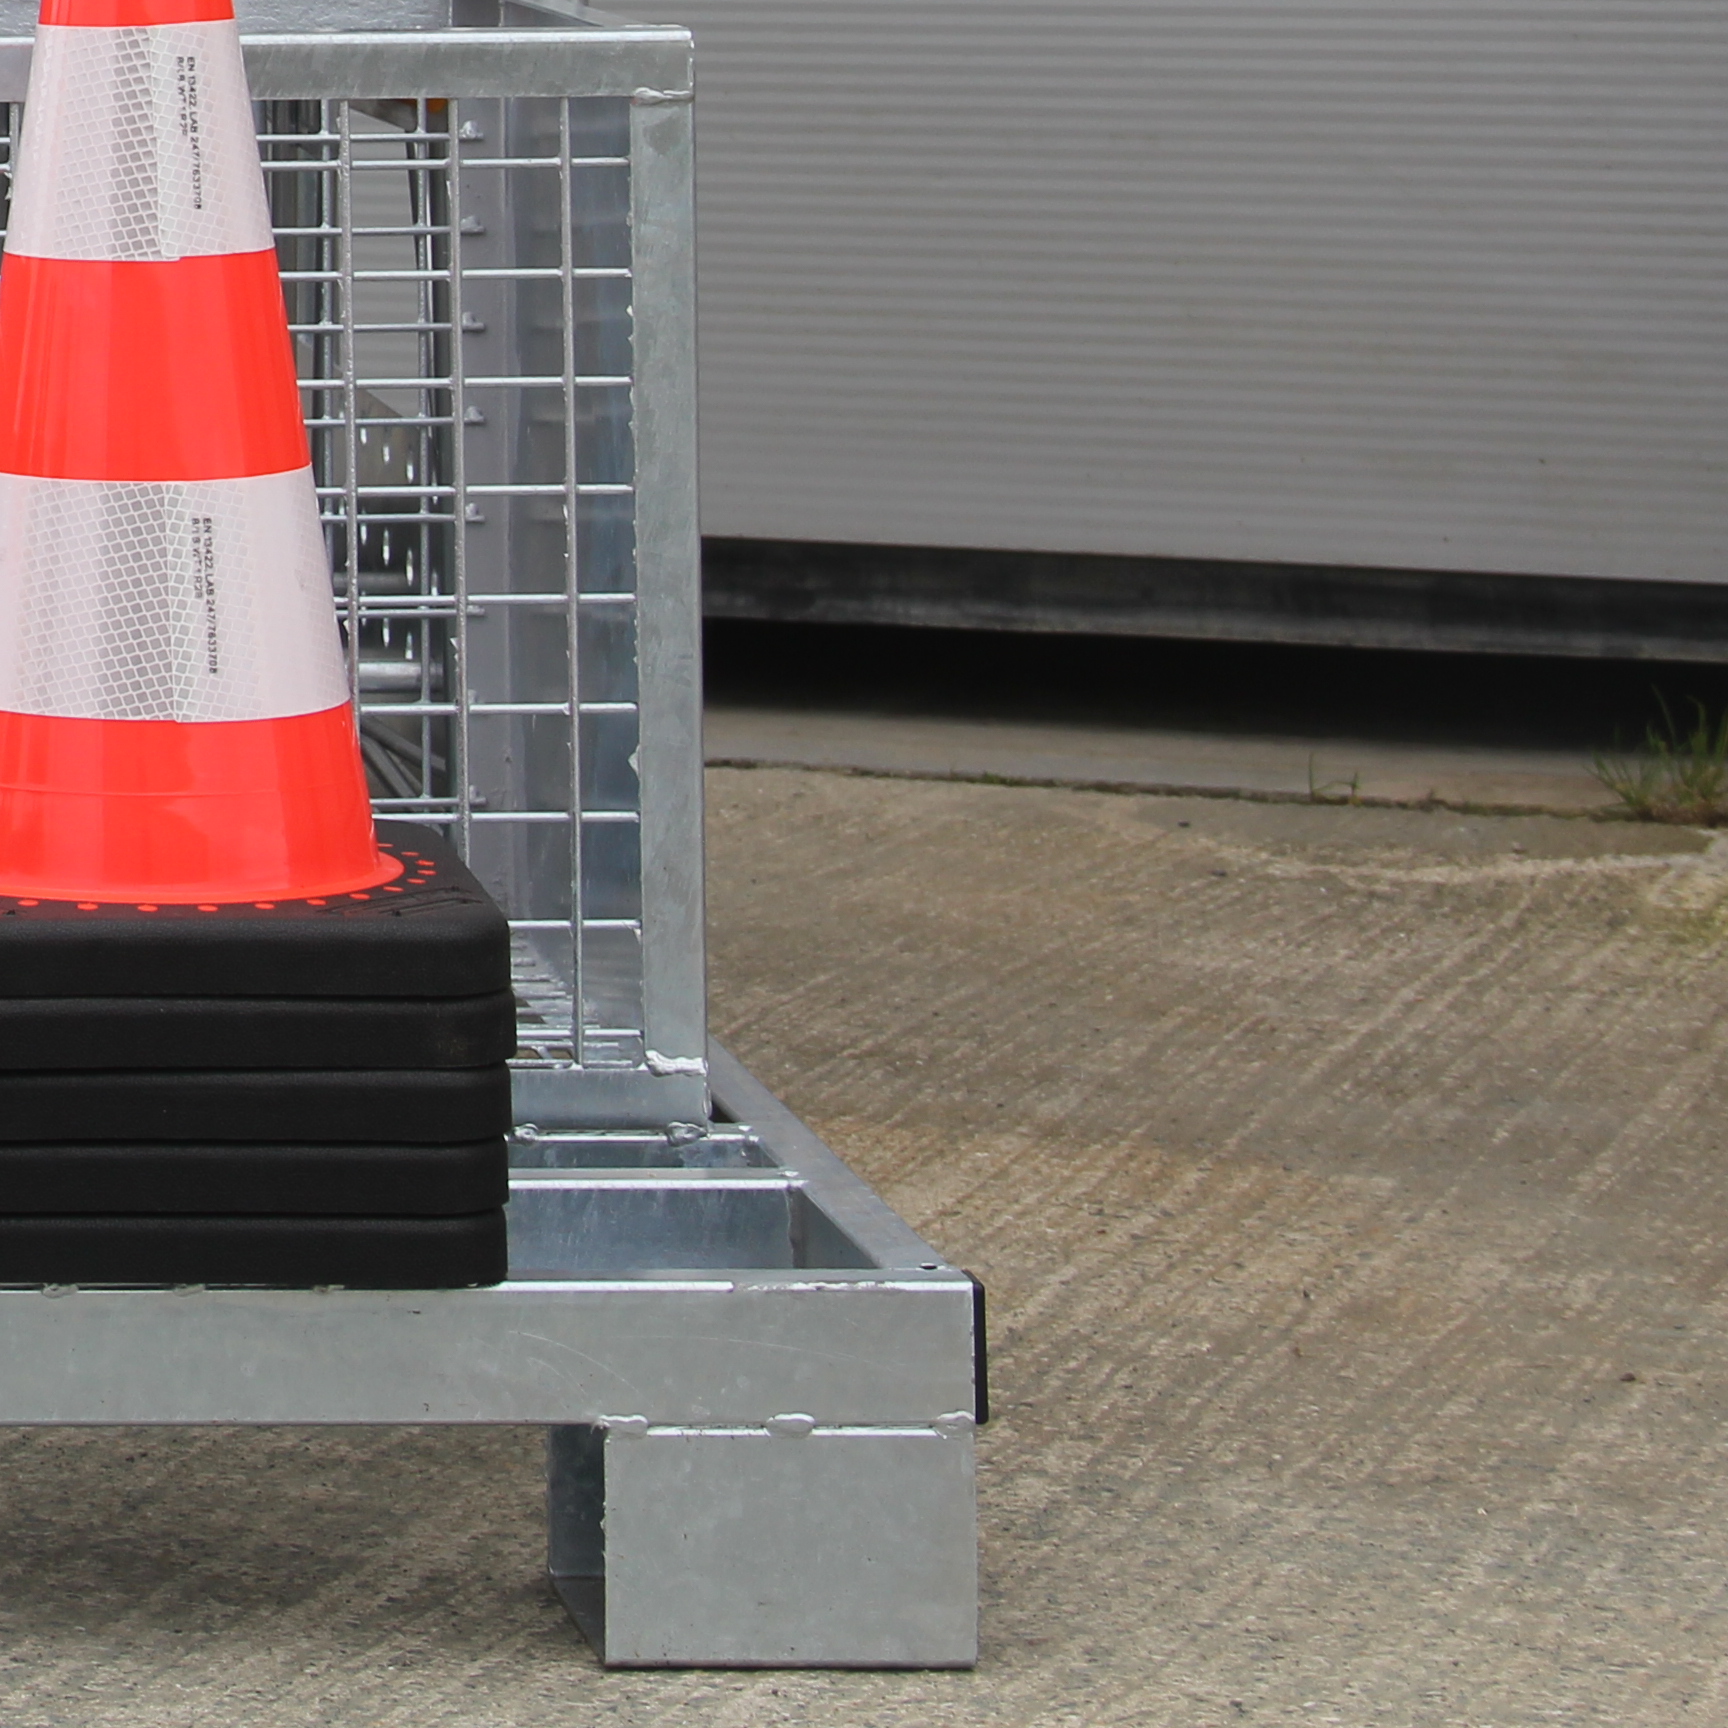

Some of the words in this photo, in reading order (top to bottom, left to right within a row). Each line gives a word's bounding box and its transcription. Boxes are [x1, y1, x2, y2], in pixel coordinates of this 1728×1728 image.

[187, 57, 196, 71] EN
[190, 111, 199, 133] LAB
[203, 518, 212, 533] EN
[205, 574, 215, 596] LAB
